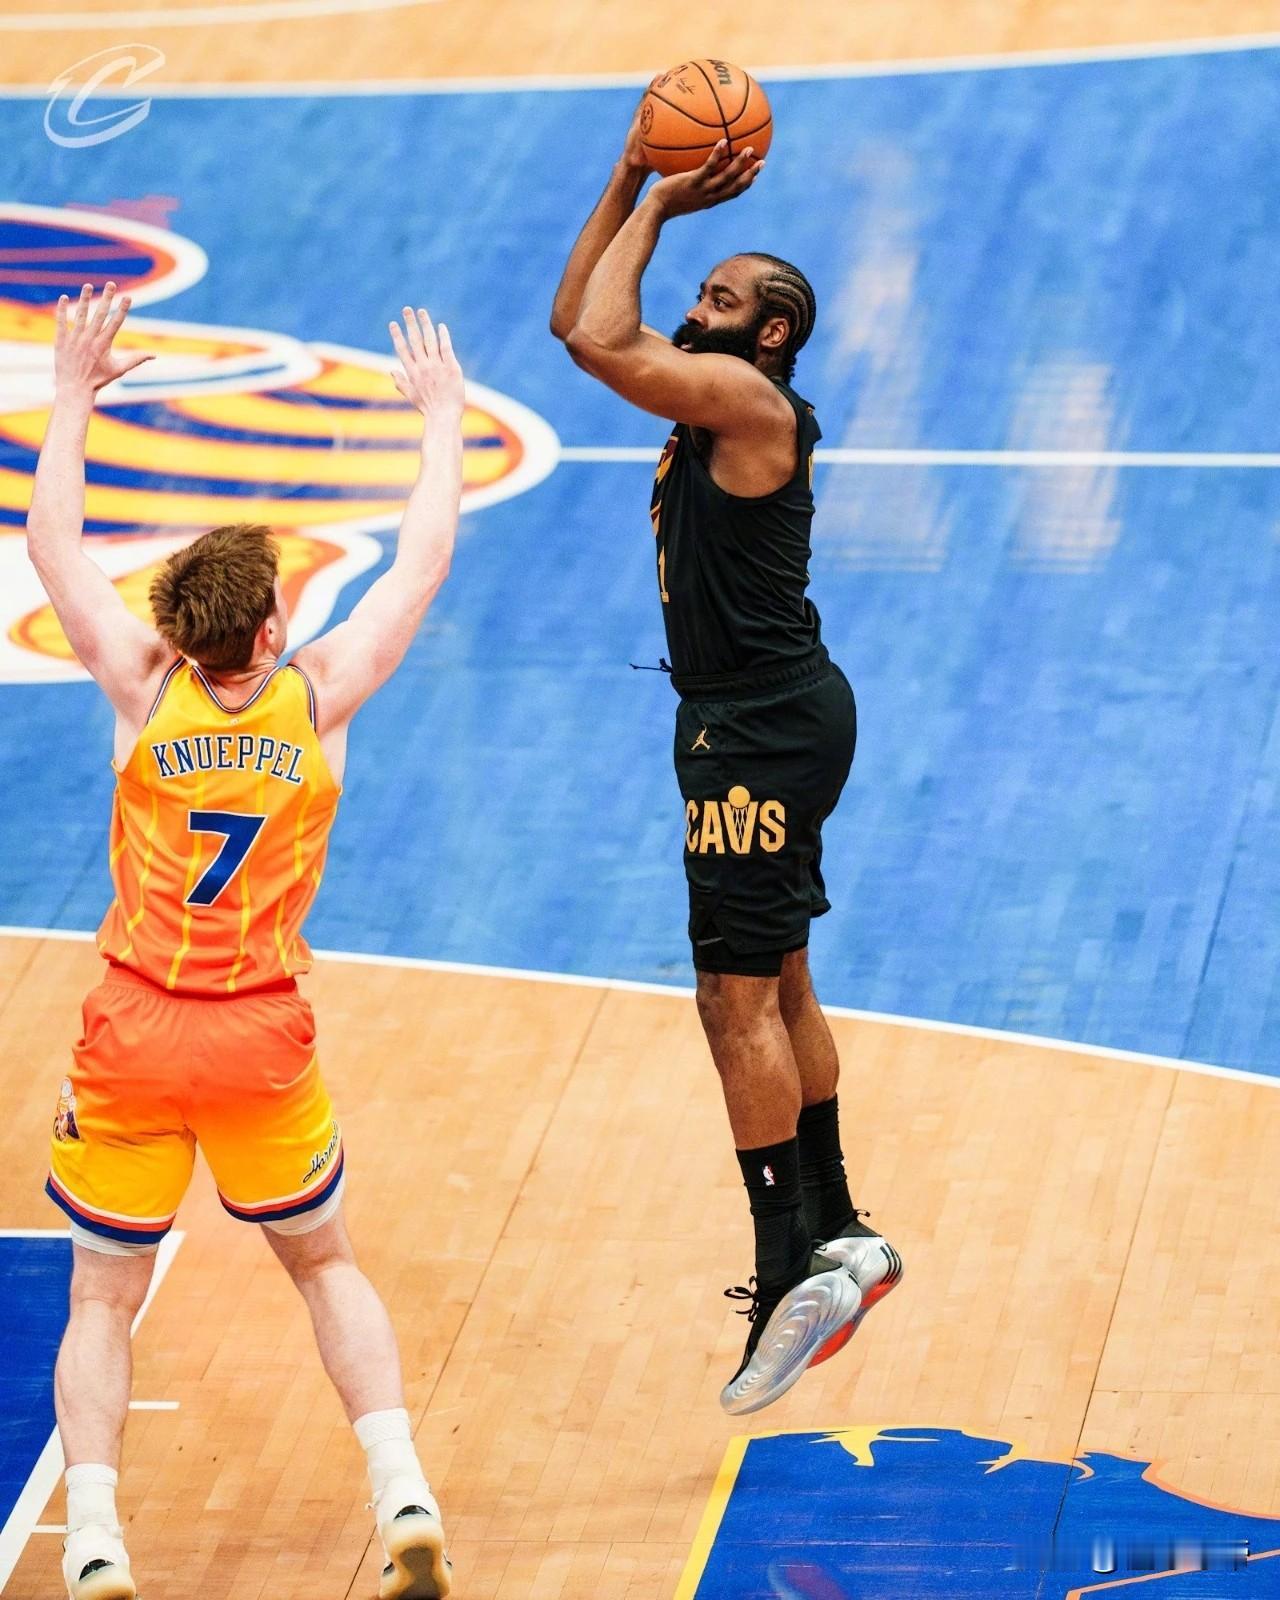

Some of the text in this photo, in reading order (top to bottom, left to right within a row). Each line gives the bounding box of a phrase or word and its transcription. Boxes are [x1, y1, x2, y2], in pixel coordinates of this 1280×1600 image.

[152, 735, 304, 785] KNUEPPEL
[686, 798, 786, 855] CAVS
[184, 808, 269, 907] 7
